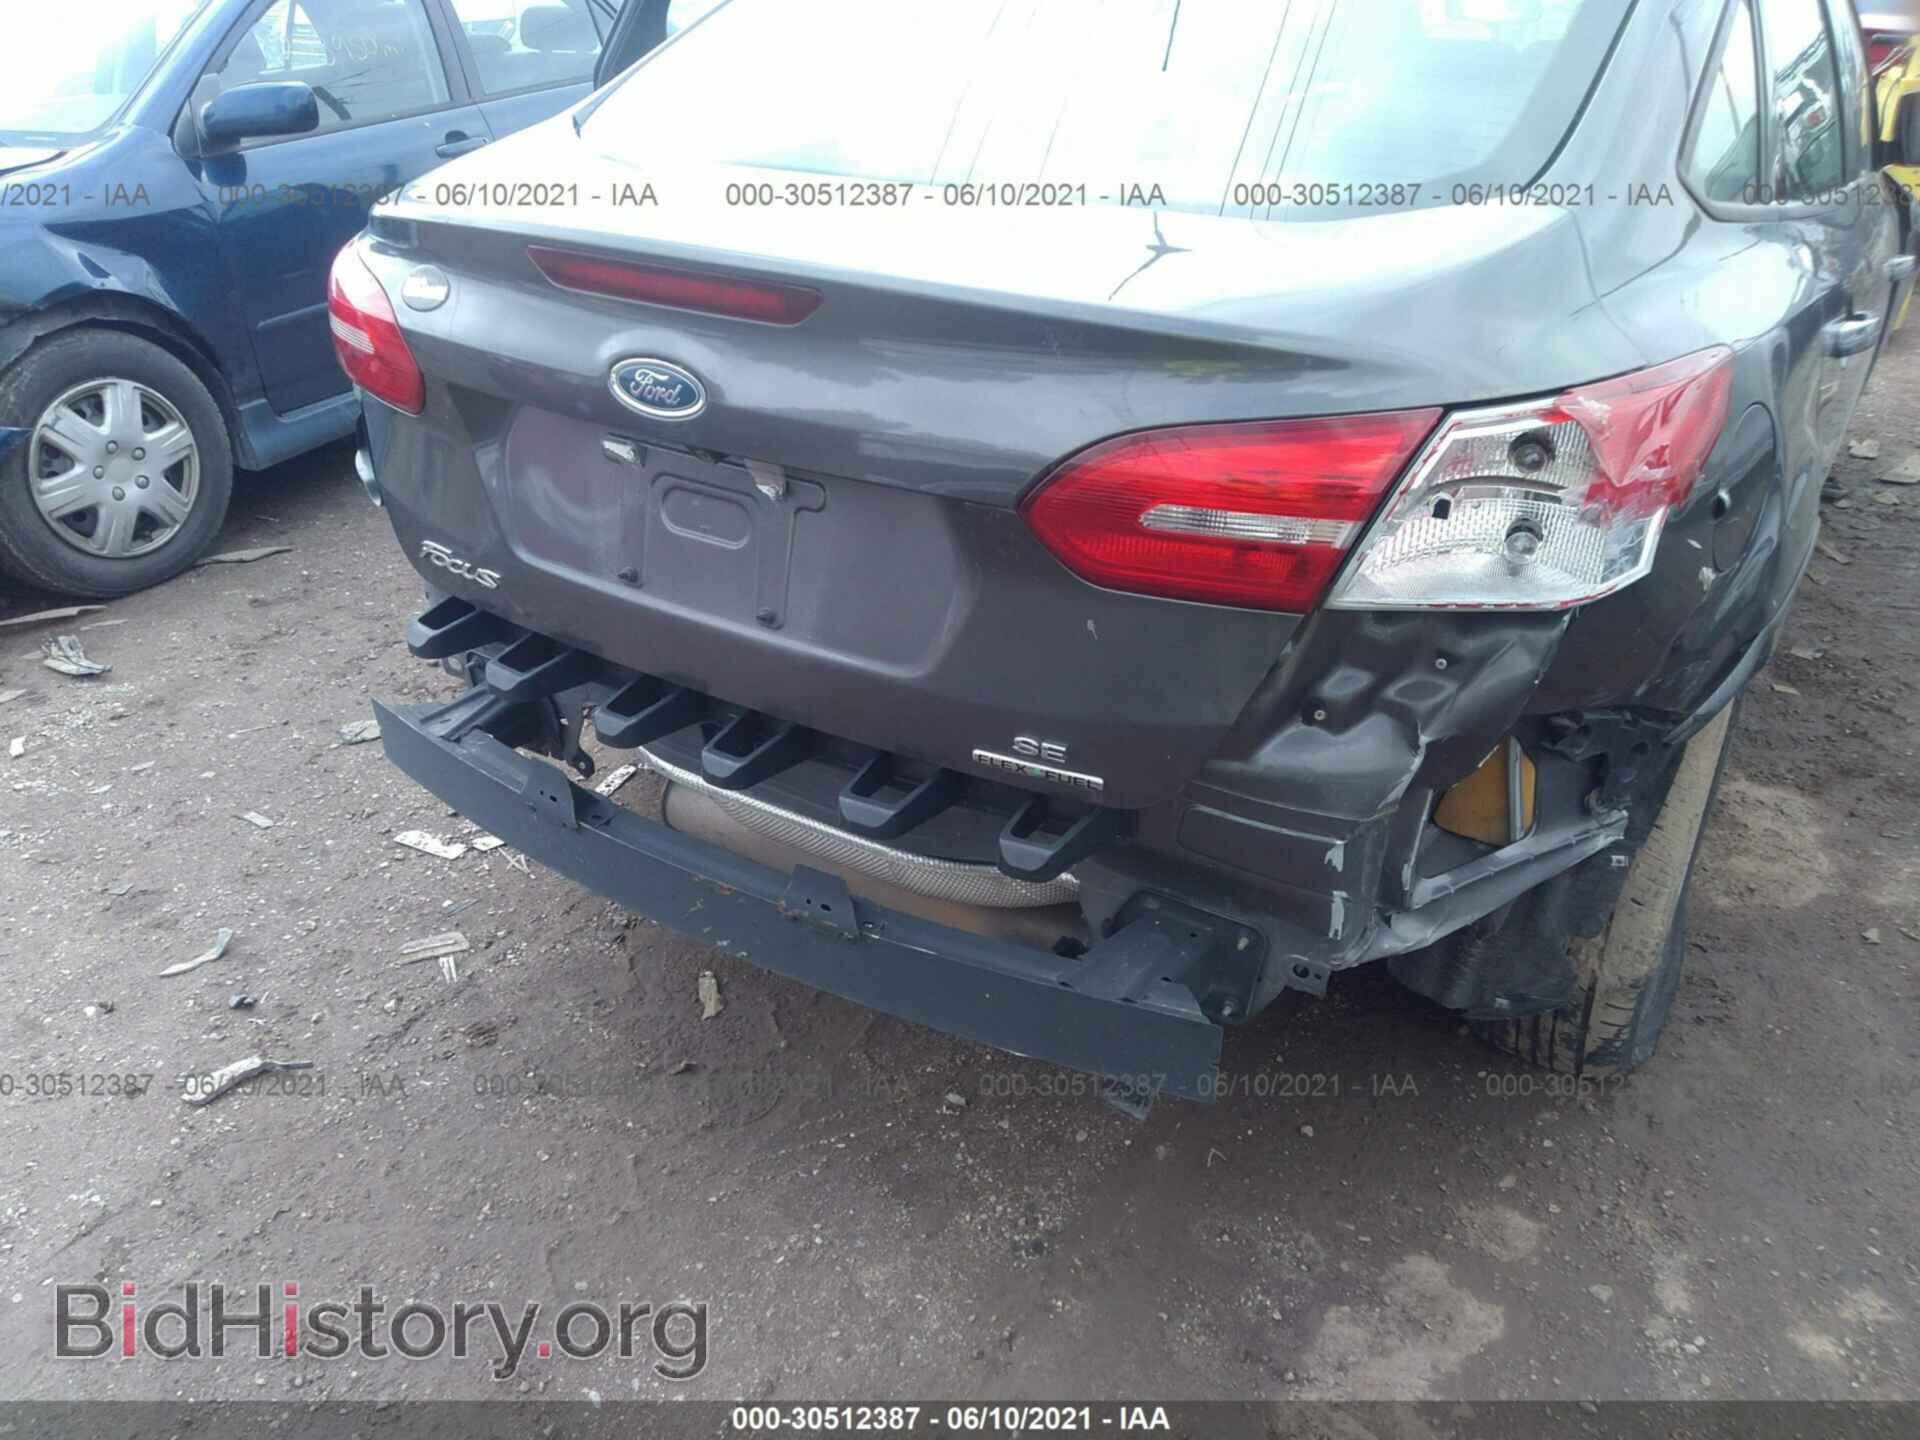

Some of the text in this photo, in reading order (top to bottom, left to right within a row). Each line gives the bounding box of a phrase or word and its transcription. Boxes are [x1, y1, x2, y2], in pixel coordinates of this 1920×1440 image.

[630, 368, 682, 405] Ford
[1012, 736, 1067, 763] SE
[977, 753, 1100, 790] FLEX FUEL
